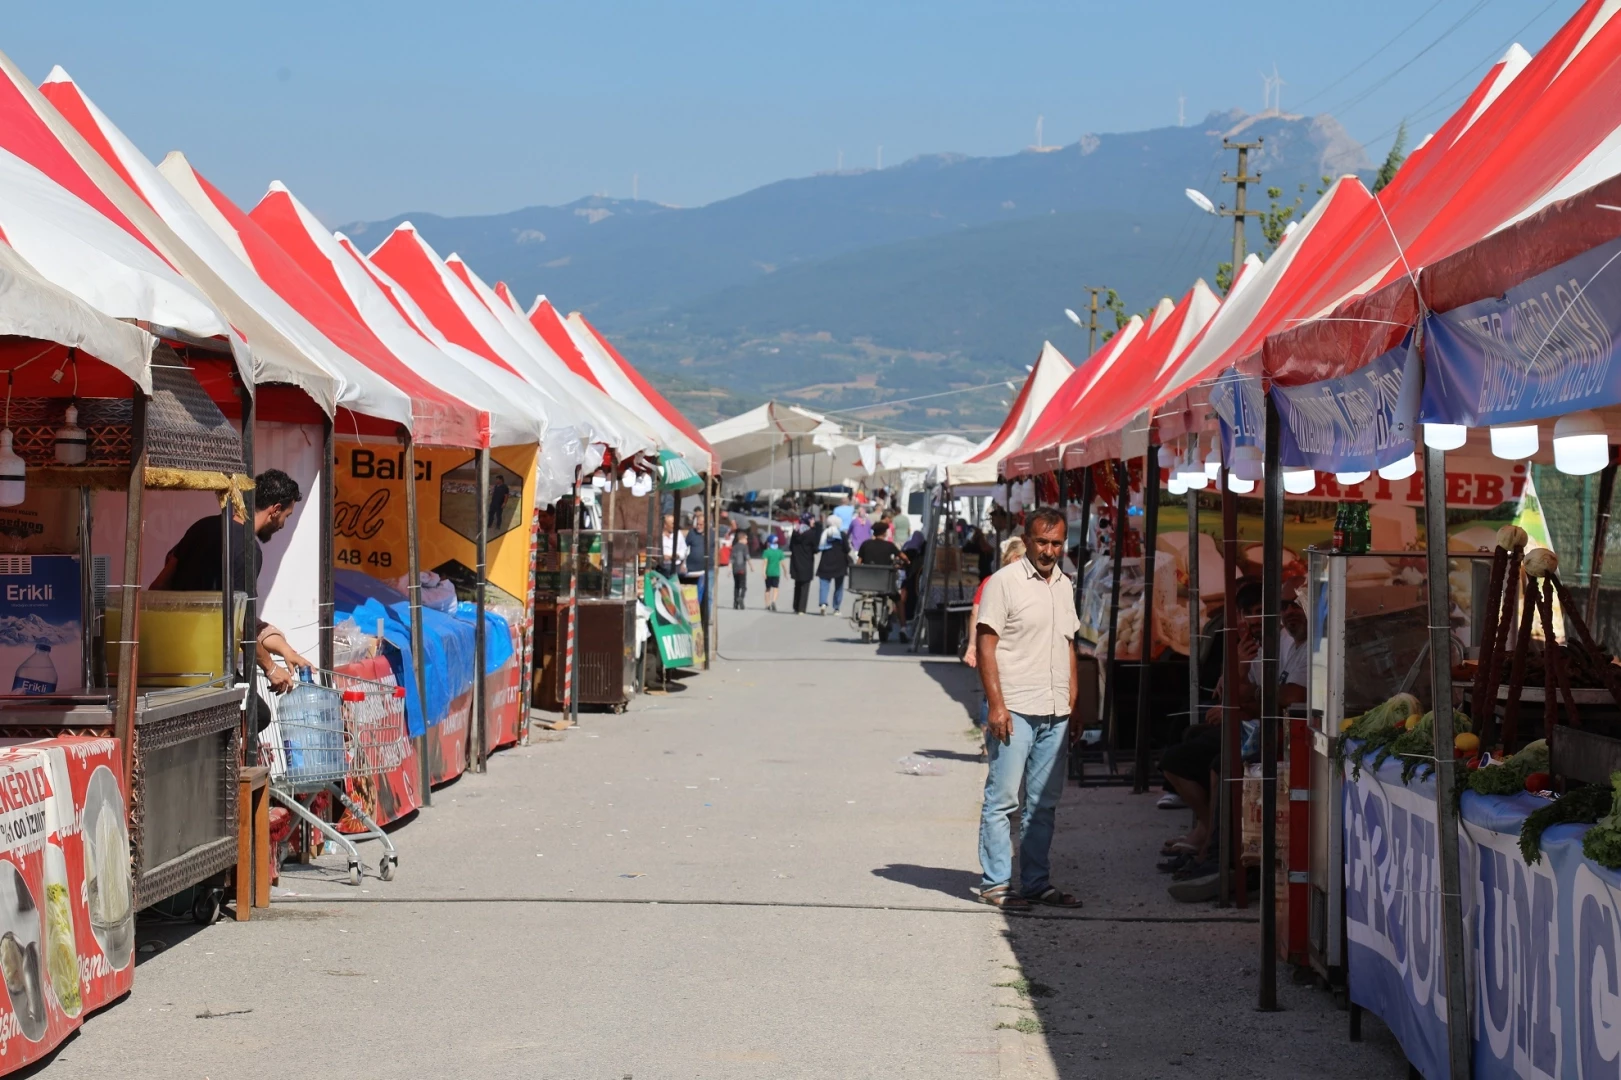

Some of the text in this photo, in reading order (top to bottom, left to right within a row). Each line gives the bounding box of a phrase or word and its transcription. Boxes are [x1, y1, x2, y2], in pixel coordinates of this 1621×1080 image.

[337, 549, 392, 568] 48 49
[7, 584, 53, 601] Erikli
[22, 680, 47, 693] Erikli
[0, 818, 27, 845] %100
